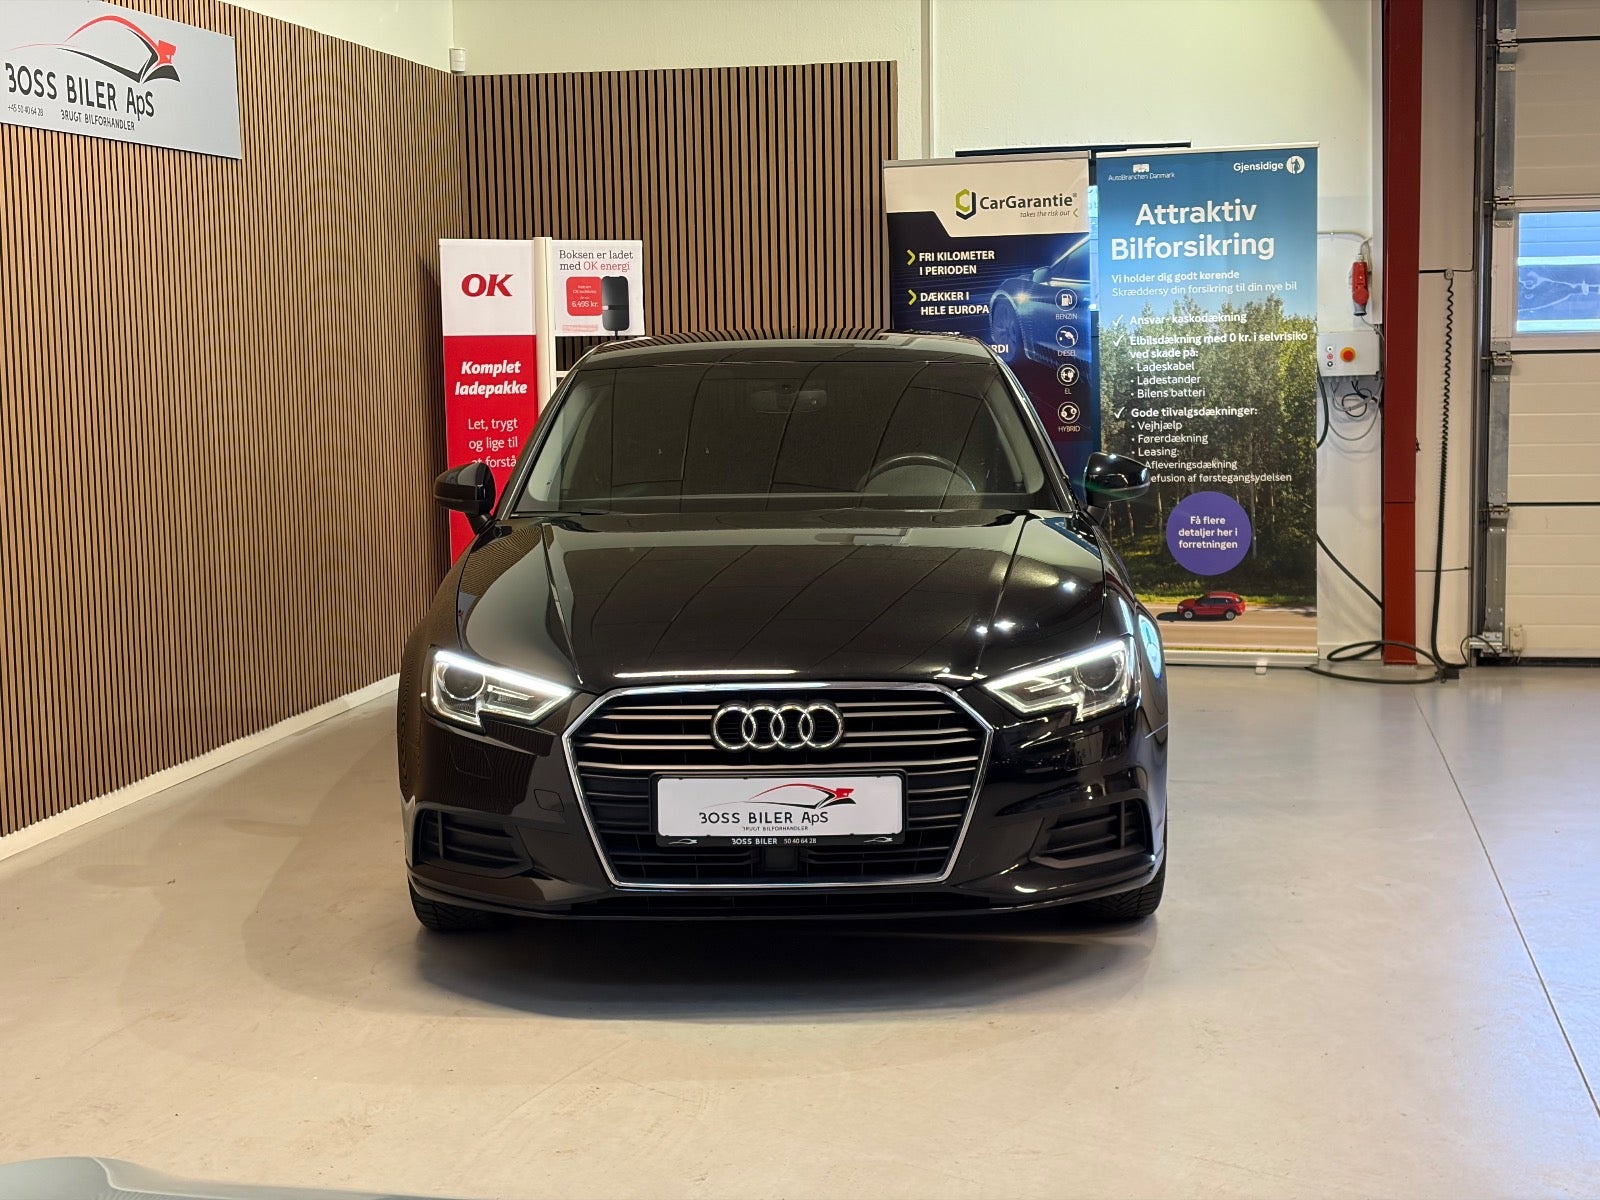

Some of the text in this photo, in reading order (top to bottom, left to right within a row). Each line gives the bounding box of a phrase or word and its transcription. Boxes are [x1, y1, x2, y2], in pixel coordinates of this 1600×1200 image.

[66, 74, 118, 111] BILER
[126, 86, 155, 121] ApS
[1233, 160, 1284, 173] Gjensidige
[1149, 172, 1175, 180] Danmark
[1020, 210, 1036, 218] takes
[1048, 209, 1059, 217] risk
[1135, 198, 1257, 226] Attraktiv
[1111, 233, 1275, 260] Bilforsikring
[559, 250, 634, 260] Boksen er ladet
[919, 250, 995, 262] FRI KILOMETER
[560, 262, 630, 273] med OK energi
[919, 265, 977, 276] I PERIODEN
[1112, 270, 1240, 284] Vi holder dig godt kørende
[461, 273, 514, 298] OK
[1112, 282, 1297, 298] Skræddersy din forsikring til din nye bil
[920, 292, 969, 302] DÆKKER I
[920, 304, 990, 315] HELE EUROPA
[1055, 313, 1078, 321] BENZIN
[1130, 313, 1248, 326] Ansvar- kaskodækning
[1130, 334, 1202, 347] Elbilsdækning
[1203, 333, 1227, 344] med
[1229, 333, 1236, 343] 0
[1238, 333, 1252, 343] kr.
[1258, 332, 1308, 342] selvrisiko
[1057, 349, 1078, 357] DIESEL
[1130, 348, 1199, 359] ved skade på:
[461, 360, 522, 377] Komplet
[1137, 362, 1195, 372] Ladeskabel
[1137, 375, 1201, 385] Ladestander
[455, 381, 528, 398] ladepakke
[1137, 388, 1206, 398] Bilens batteri
[1131, 407, 1258, 419] Gode tilvalgsdækninger:
[468, 418, 518, 432] Let, trygt
[1058, 425, 1081, 433] HYBRID
[1138, 421, 1182, 431] Vejhjælp
[468, 436, 518, 453] og lige til
[1138, 433, 1208, 445] Førerdækning
[1138, 447, 1180, 458] Leasing:
[486, 455, 517, 468] forstå
[1145, 460, 1238, 471] Afleveringsdækning
[1150, 472, 1292, 484] efusion af førstegangsydelsen
[1190, 515, 1226, 524] Få flere
[1178, 528, 1215, 538] detaljer
[1217, 528, 1233, 537] her
[1178, 540, 1238, 550] forretningen
[748, 811, 793, 824] BILER
[801, 811, 829, 826] ApS
